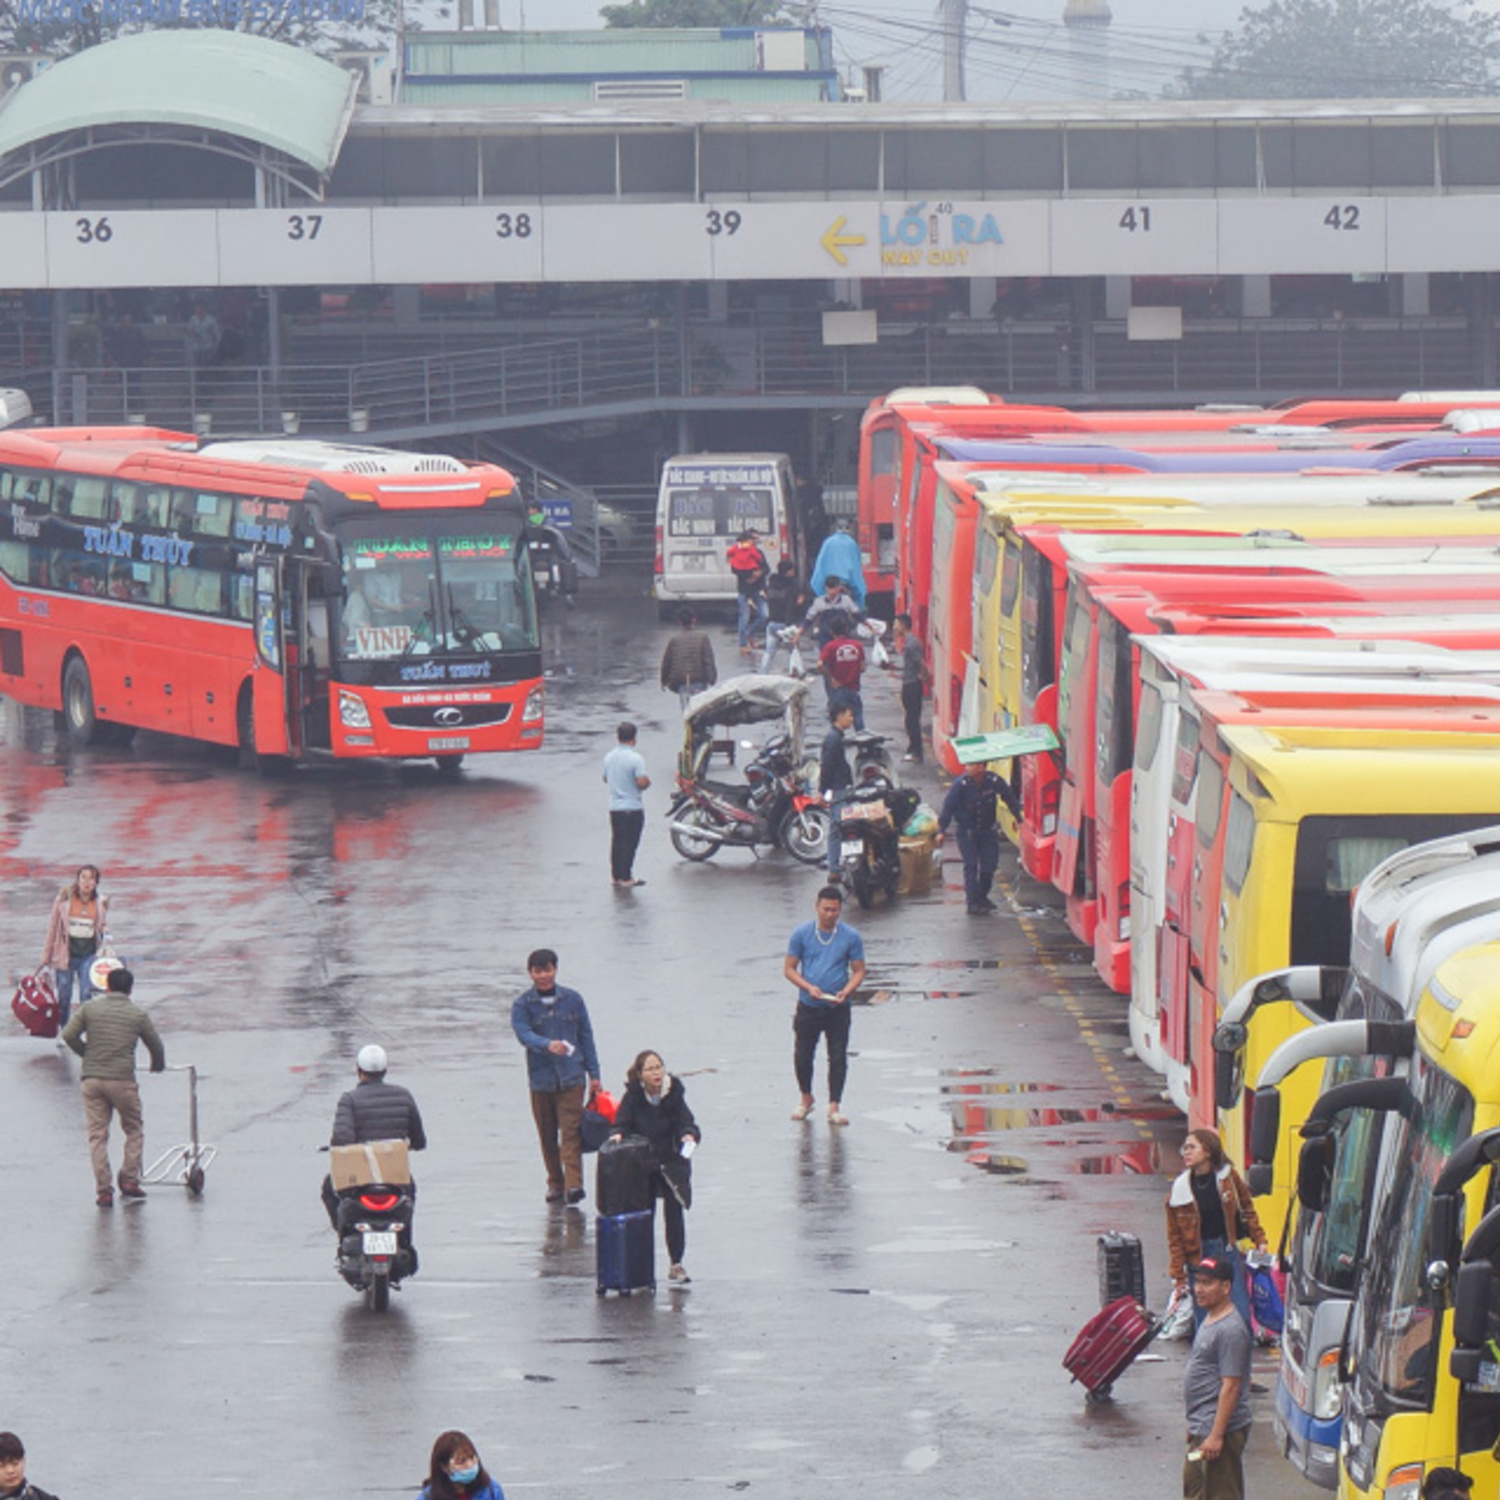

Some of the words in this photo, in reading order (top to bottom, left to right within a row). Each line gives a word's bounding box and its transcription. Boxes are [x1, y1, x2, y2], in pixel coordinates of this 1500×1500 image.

[76, 216, 113, 244] 36
[287, 214, 323, 241] 37
[495, 212, 532, 239] 38
[705, 210, 742, 237] 39
[952, 213, 1004, 245] RA
[1118, 206, 1152, 233] 41
[1323, 204, 1361, 231] 42
[928, 249, 969, 266] OUT
[357, 628, 410, 651] VINH
